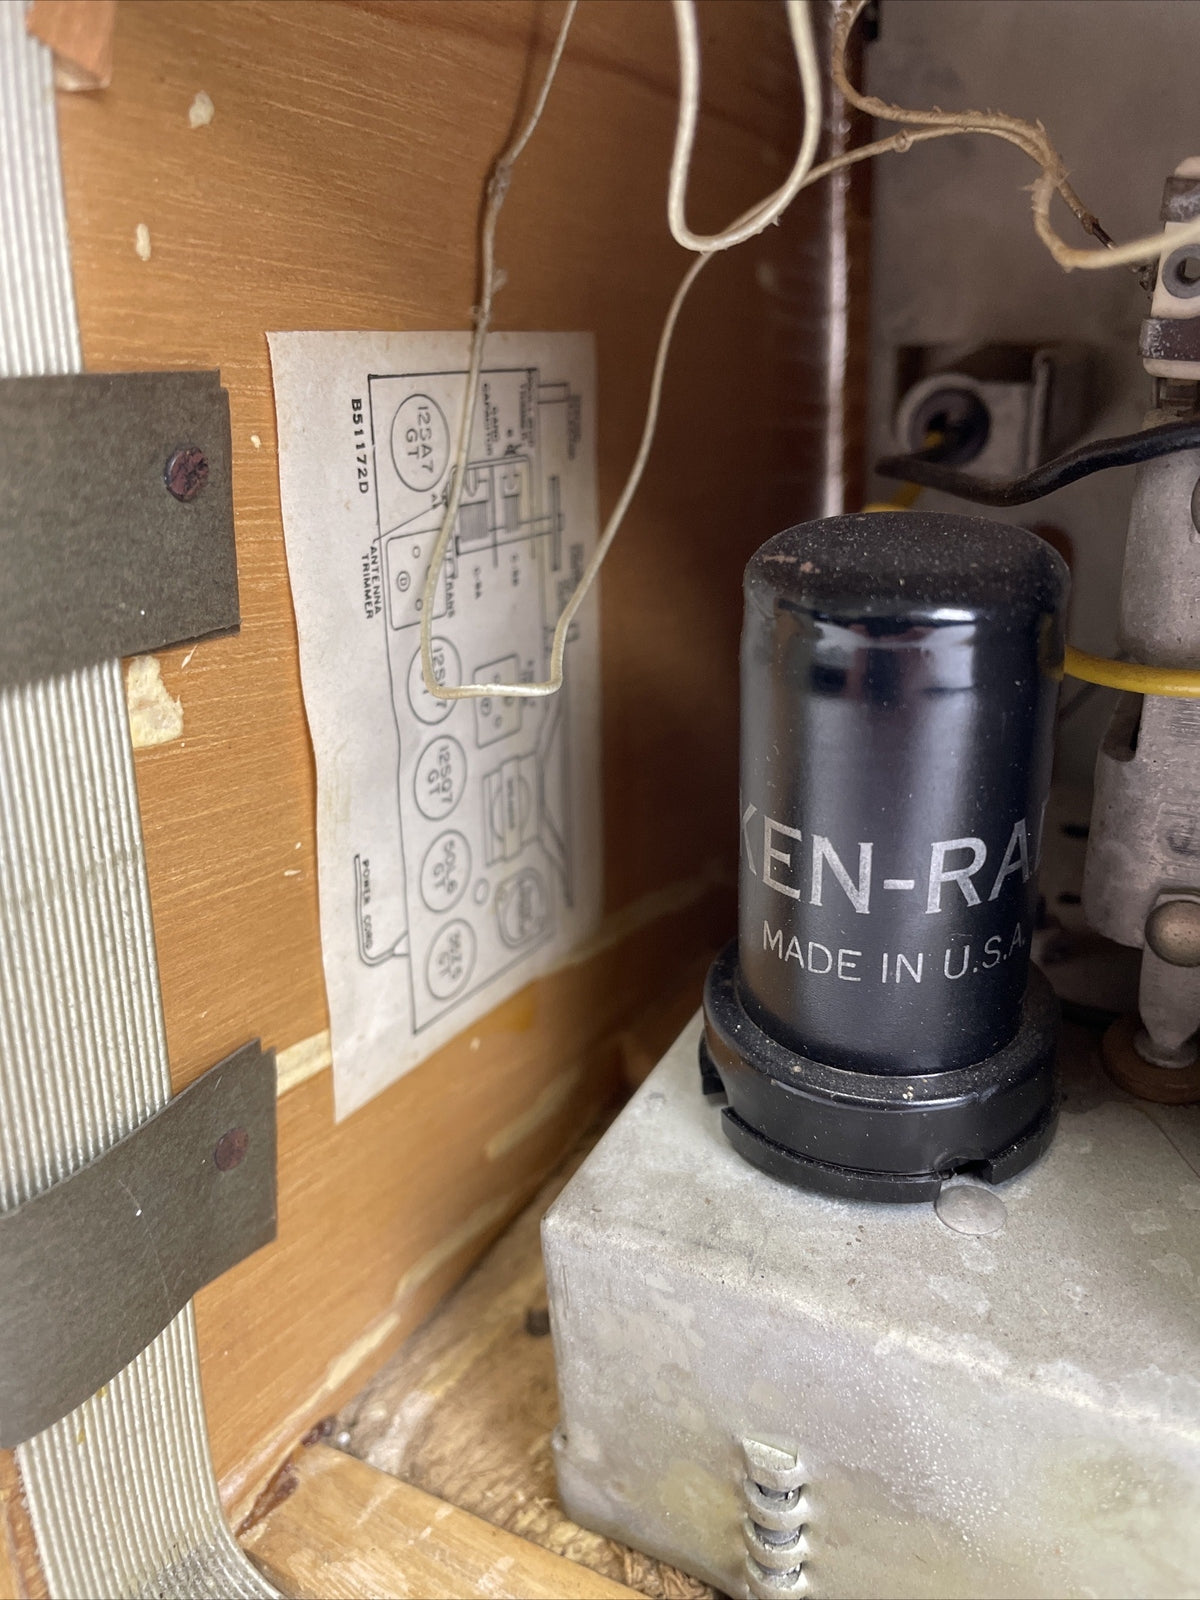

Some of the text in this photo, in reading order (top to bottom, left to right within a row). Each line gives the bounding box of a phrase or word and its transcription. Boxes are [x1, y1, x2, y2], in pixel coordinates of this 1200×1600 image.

[352, 398, 369, 494] B51172D
[406, 428, 419, 460] GT
[417, 405, 434, 473] 12SA7
[361, 553, 375, 620] TRIMMER
[370, 545, 382, 616] ANTENNA
[427, 768, 441, 797] GT
[438, 745, 453, 804] 12SQ7
[362, 858, 374, 951] POWER CORD
[432, 861, 447, 891] GT
[763, 920, 863, 982] MADE
[881, 952, 924, 984] IN
